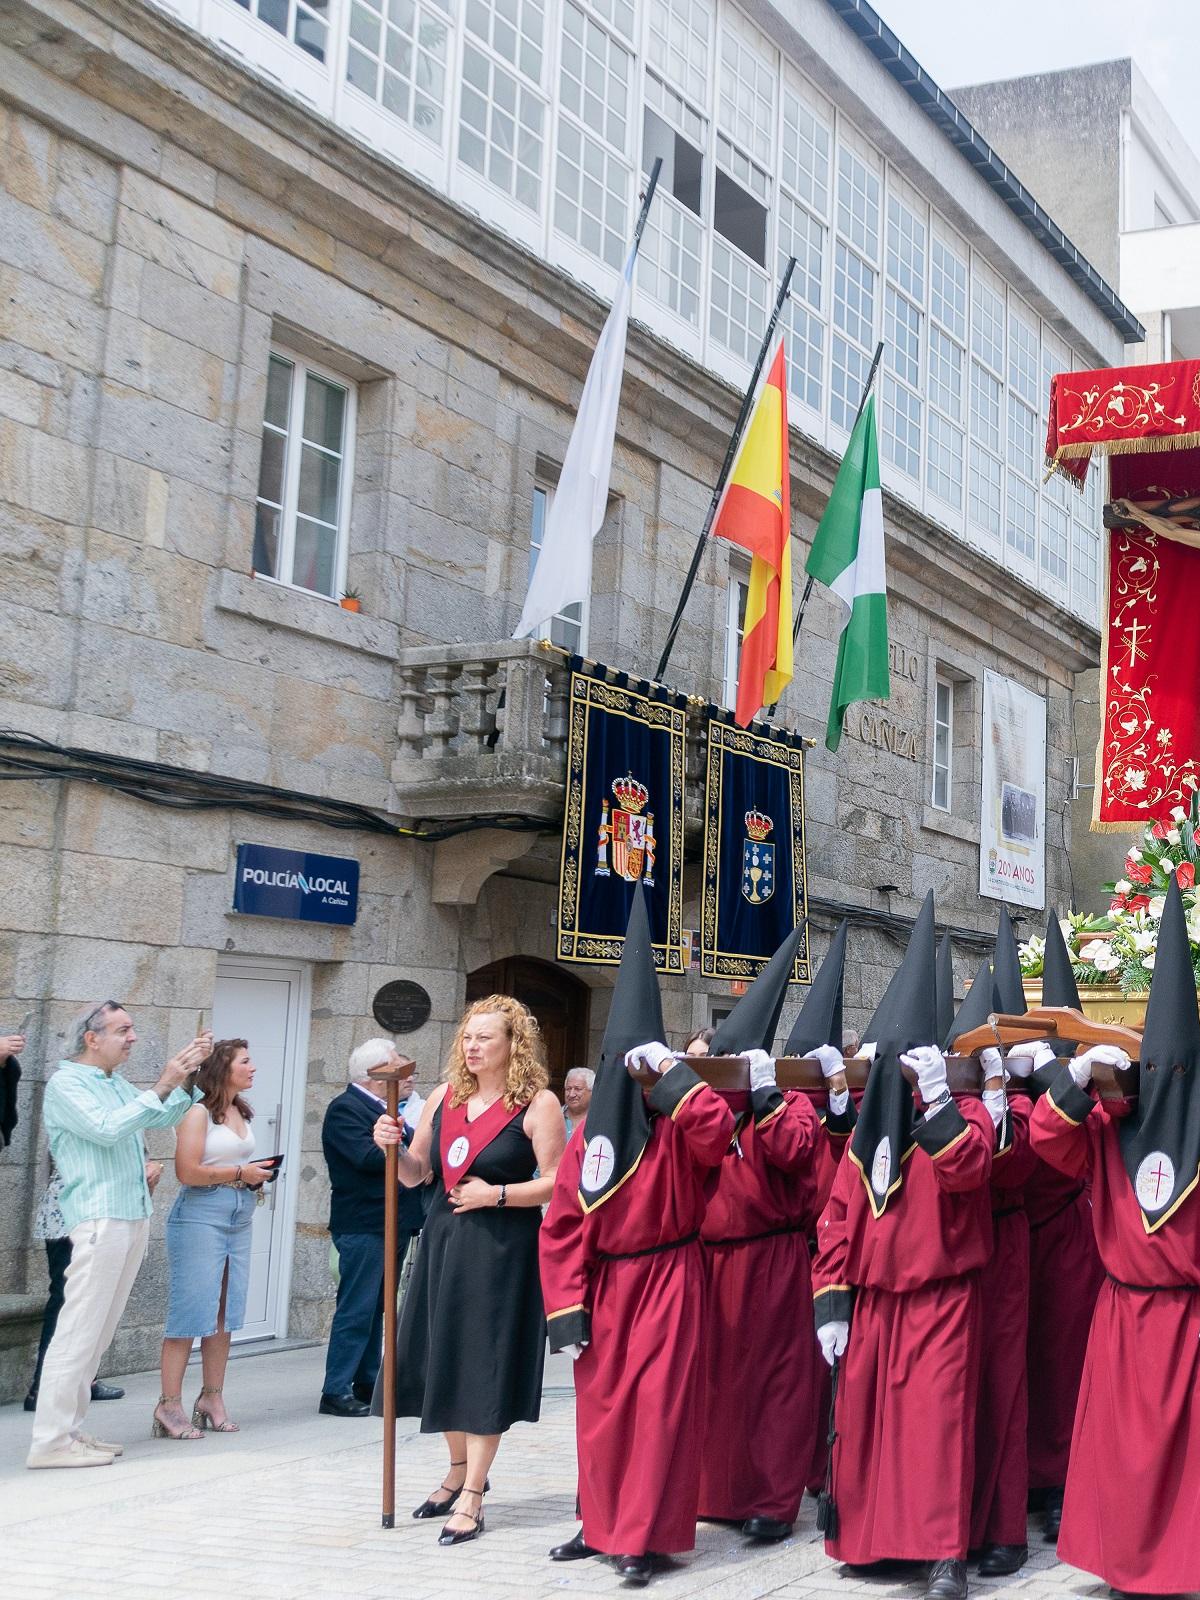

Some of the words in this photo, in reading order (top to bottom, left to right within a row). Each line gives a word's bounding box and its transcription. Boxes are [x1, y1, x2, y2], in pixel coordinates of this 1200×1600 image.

[242, 868, 299, 889] POLICÍA
[309, 876, 350, 895] LOCAL
[322, 896, 328, 904] A
